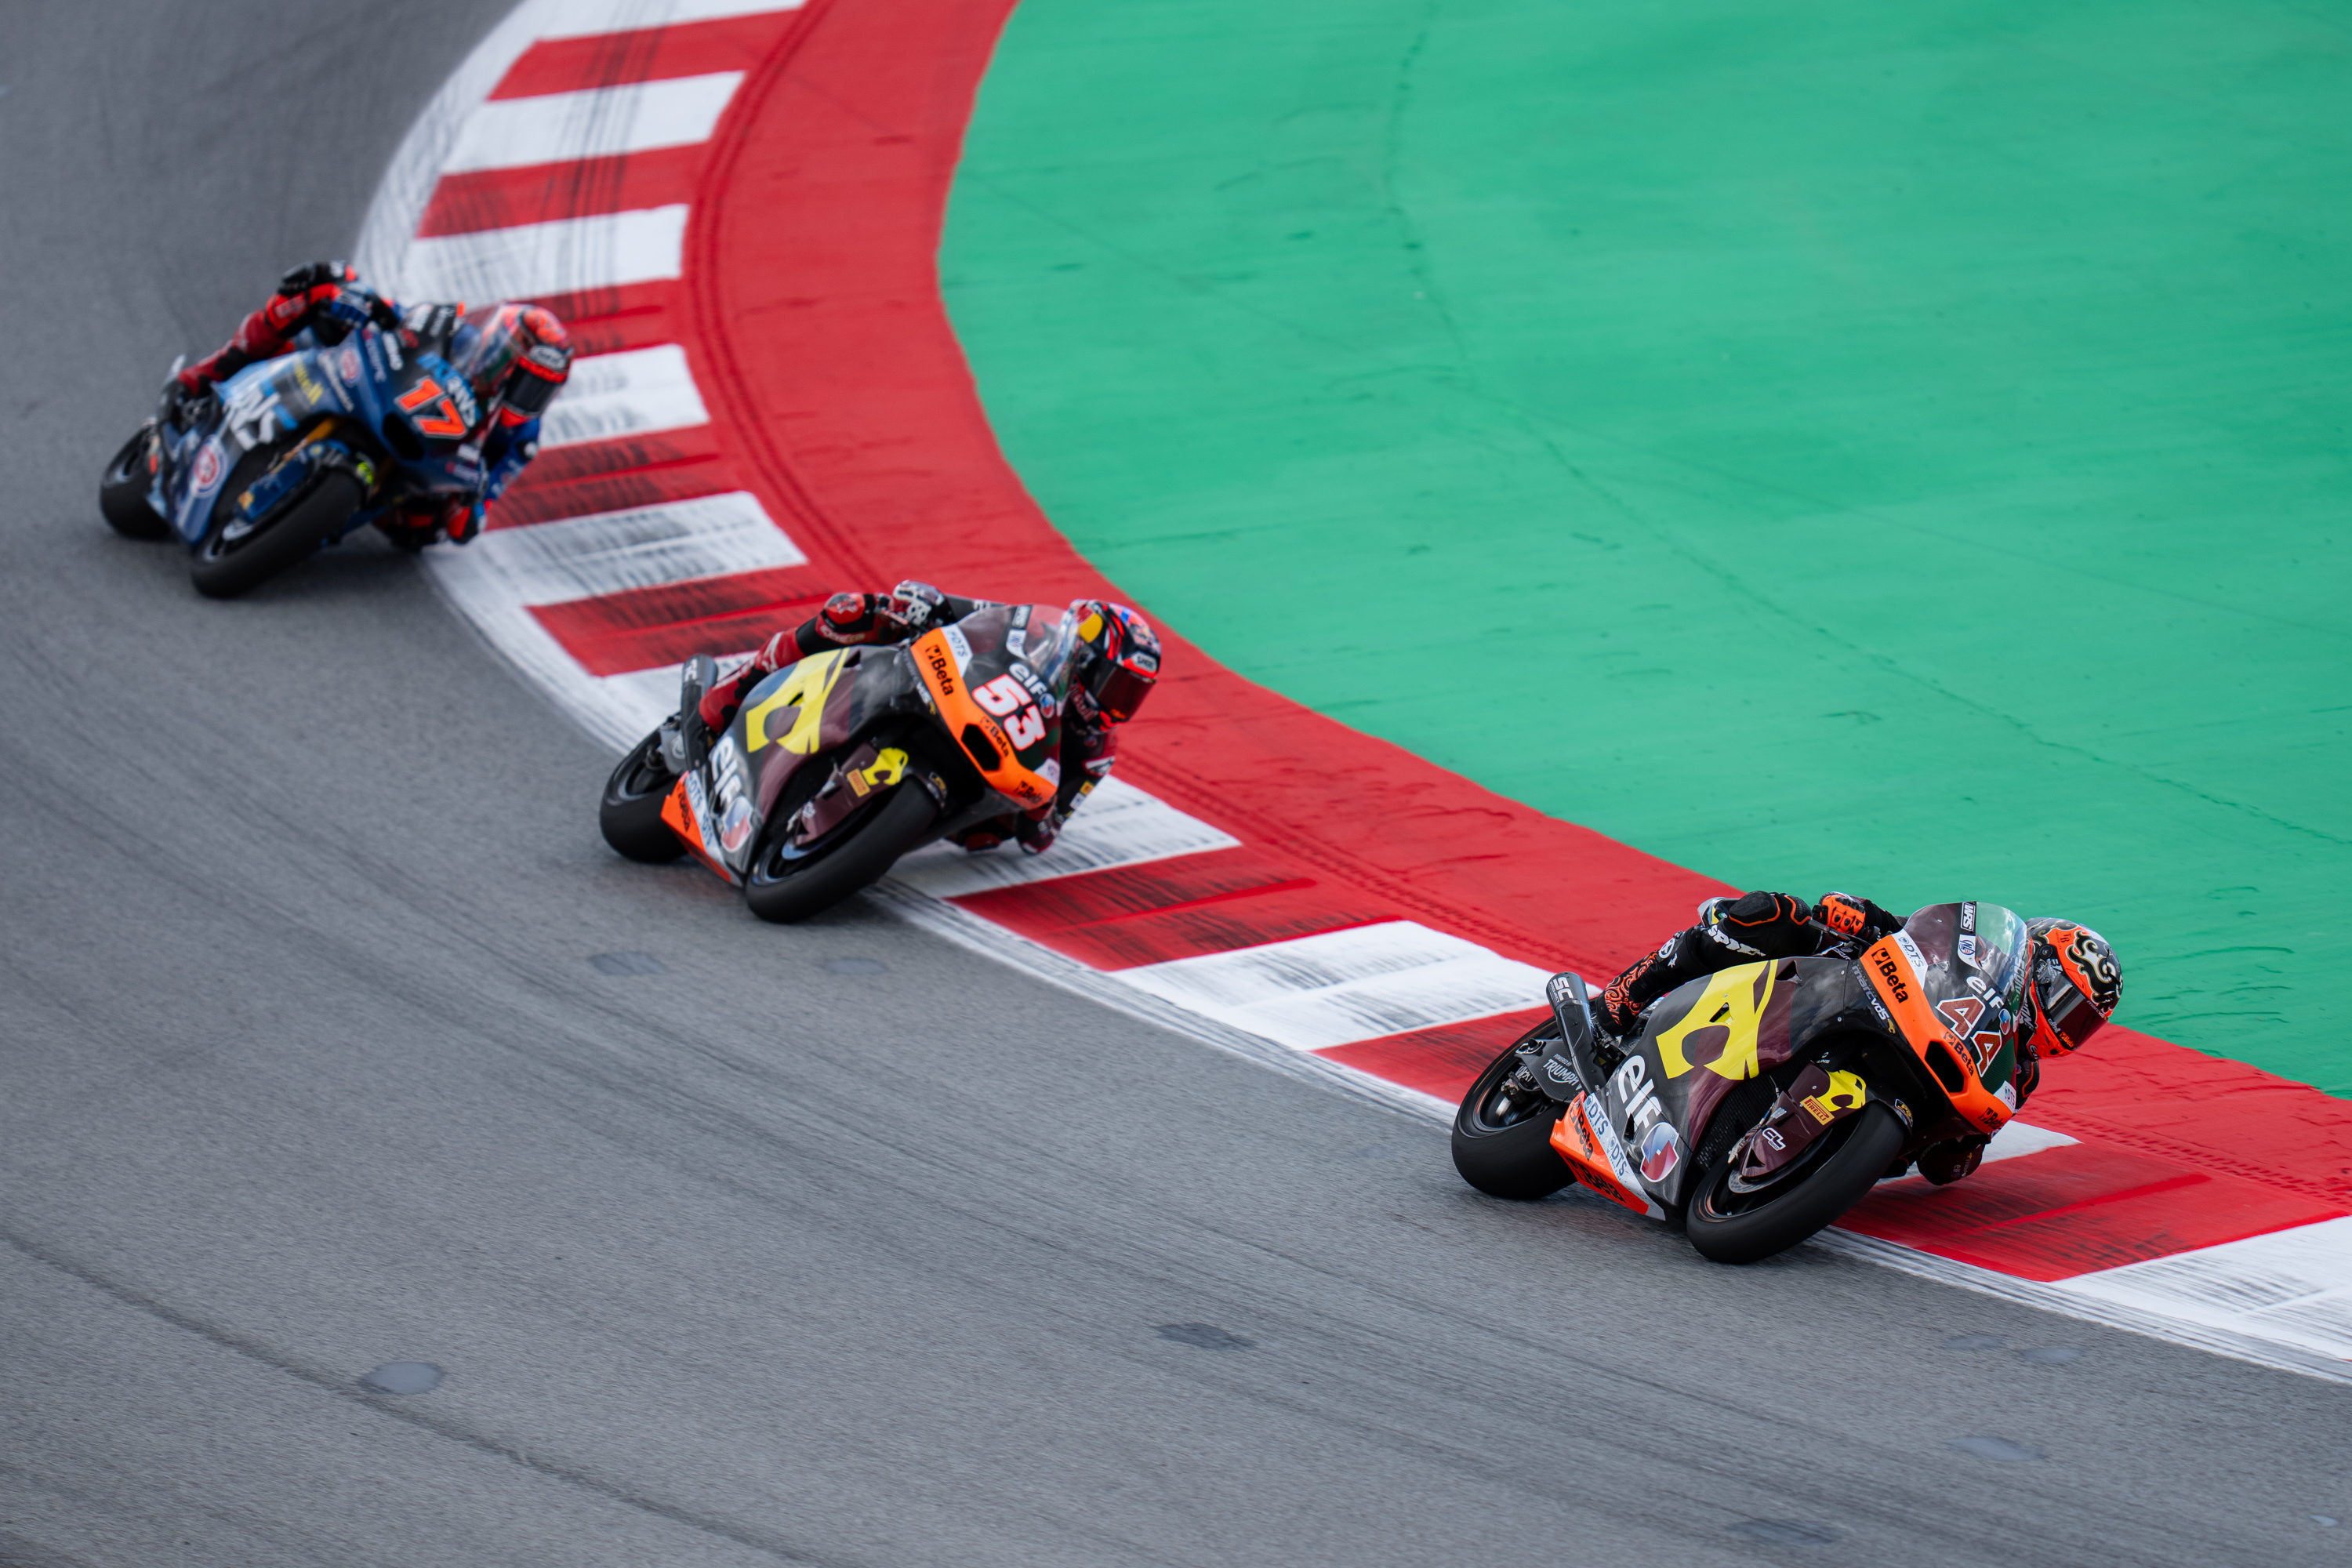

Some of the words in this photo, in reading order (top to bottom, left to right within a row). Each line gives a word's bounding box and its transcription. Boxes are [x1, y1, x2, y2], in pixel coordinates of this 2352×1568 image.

[397, 377, 467, 439] 17
[931, 656, 954, 696] Beta
[1009, 662, 1048, 695] elf
[971, 673, 1046, 751] 53
[989, 726, 1009, 757] Beta
[1903, 943, 1924, 967] DTS
[1552, 977, 1573, 1001] SC
[1879, 961, 1908, 1004] Beta
[1966, 975, 2005, 1009] elf
[2064, 1035, 2074, 1047] Beta
[1543, 1058, 1580, 1087] TRIUMPH
[1954, 1040, 1974, 1077] Beta
[1618, 1055, 1662, 1134] elf
[1804, 1098, 1830, 1122] PIRELLI
[1588, 1102, 1608, 1135] DTS
[1986, 1109, 2003, 1129] Beta
[1574, 1112, 1594, 1162] Beta
[1764, 1127, 1784, 1149] CL
[1611, 1146, 1628, 1177] DTS
